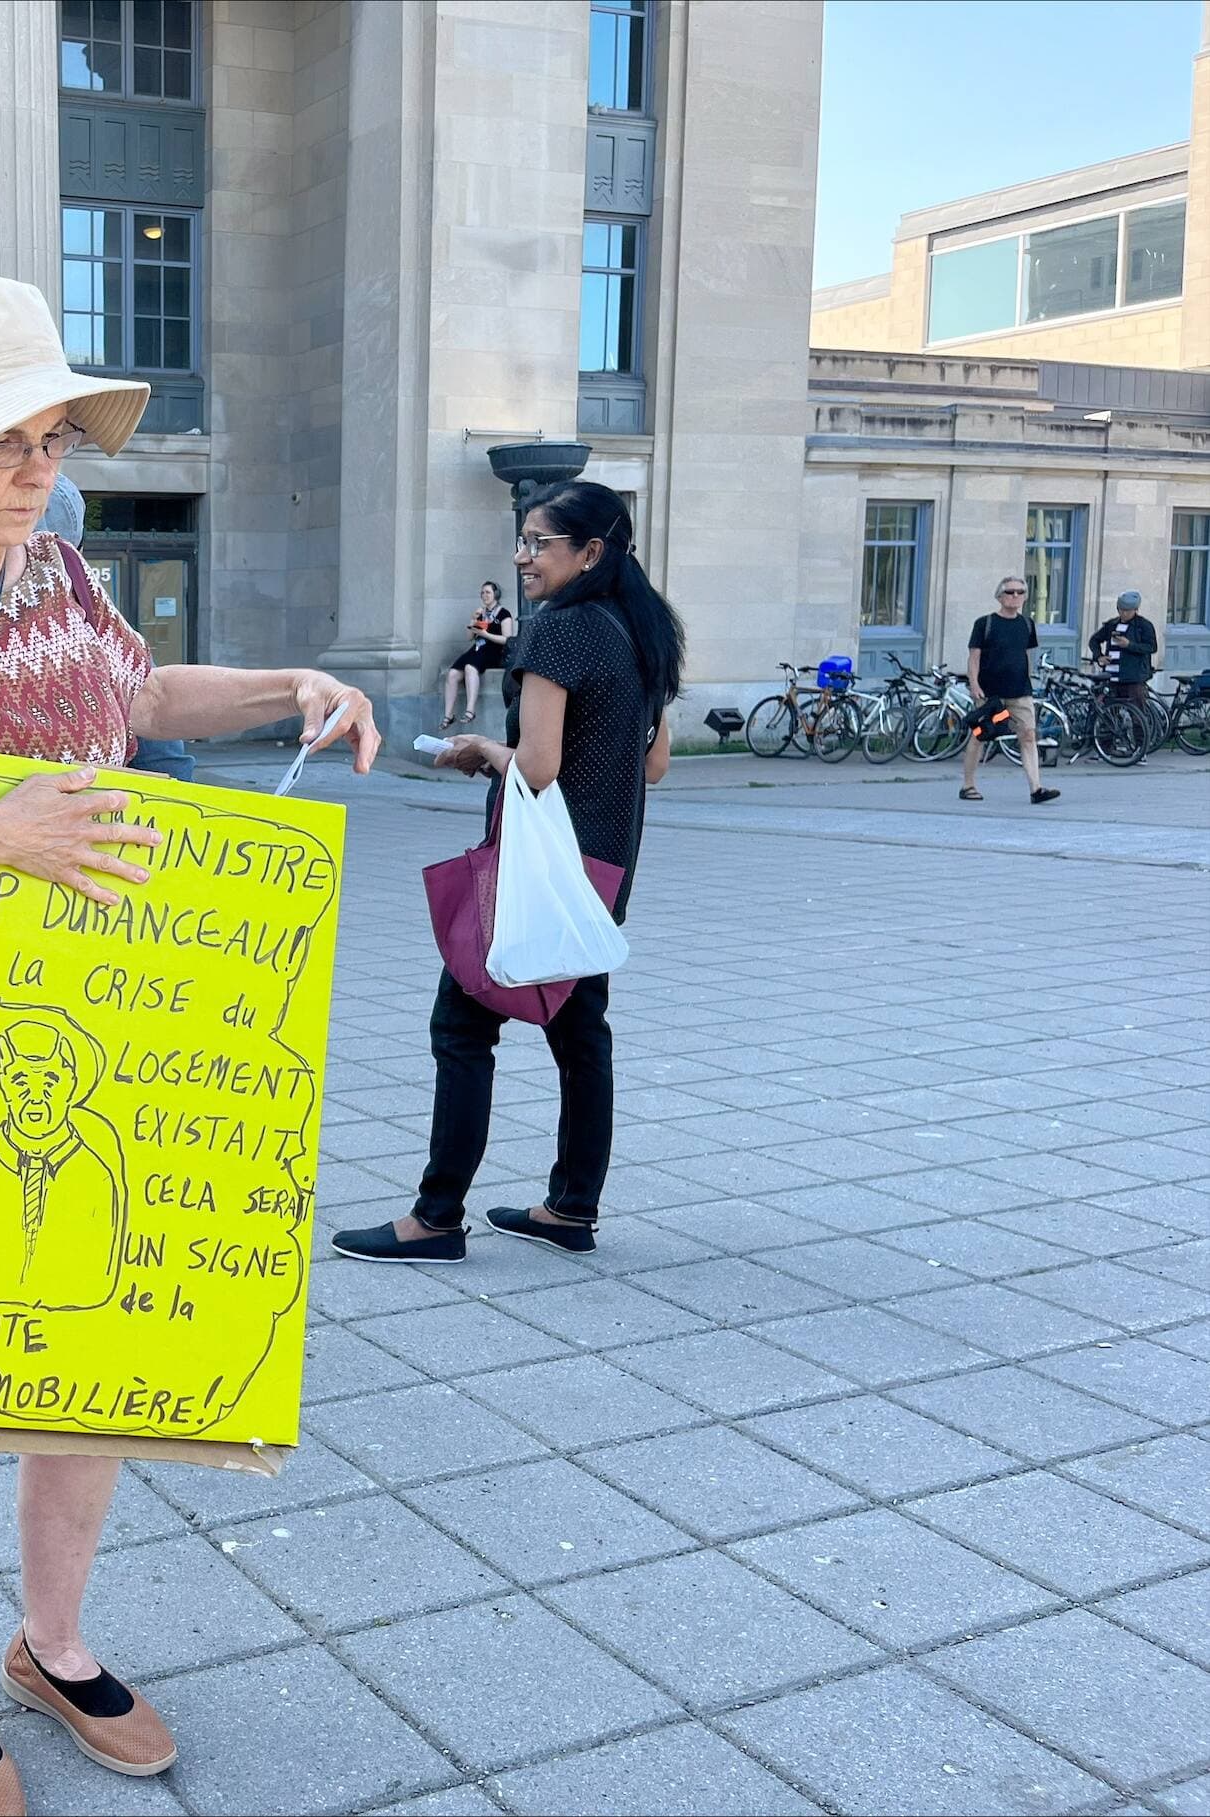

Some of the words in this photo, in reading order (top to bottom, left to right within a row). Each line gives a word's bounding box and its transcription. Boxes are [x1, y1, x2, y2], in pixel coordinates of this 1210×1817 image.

[118, 815, 333, 893] MINISTRE
[84, 962, 194, 1013] CRISE
[223, 994, 256, 1030] du
[114, 1040, 315, 1100] LOGEMENT
[144, 1173, 216, 1212] CELA
[124, 1233, 165, 1269] UN
[188, 1237, 293, 1277] SIGNE
[121, 1283, 154, 1316] de
